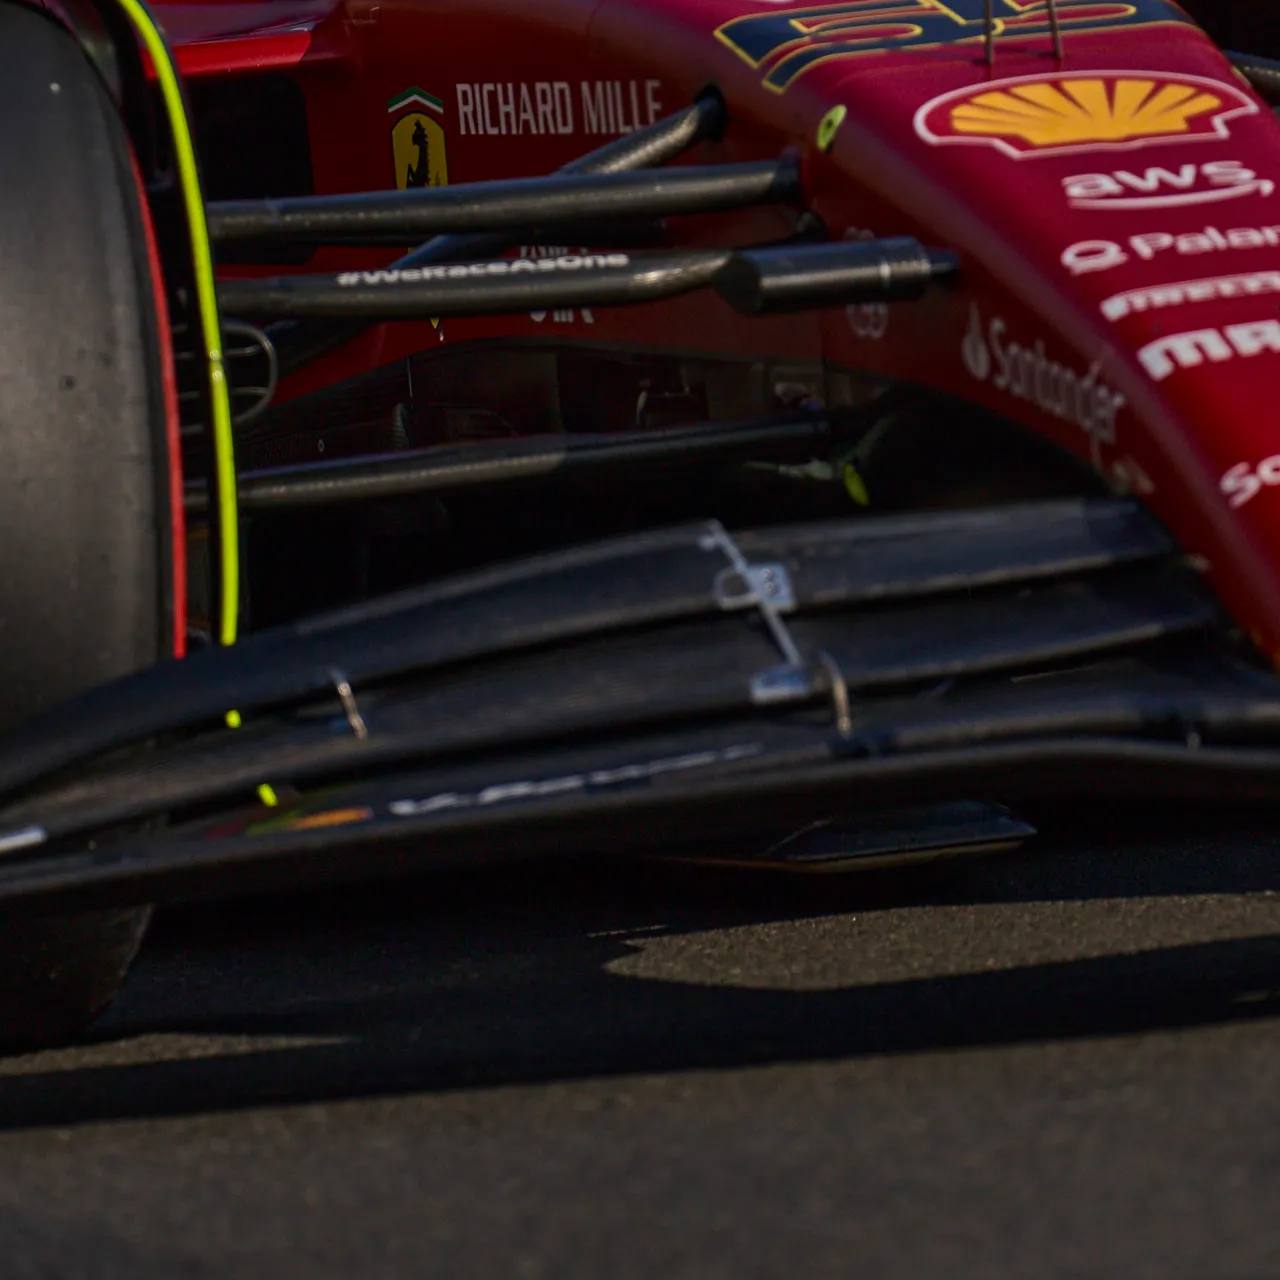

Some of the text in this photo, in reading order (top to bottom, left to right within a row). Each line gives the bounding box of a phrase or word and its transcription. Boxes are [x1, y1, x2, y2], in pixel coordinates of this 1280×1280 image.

[456, 78, 663, 136] RICHARD MILLE
[1061, 159, 1260, 202] aws
[336, 252, 630, 288] #WeRaceAsOne
